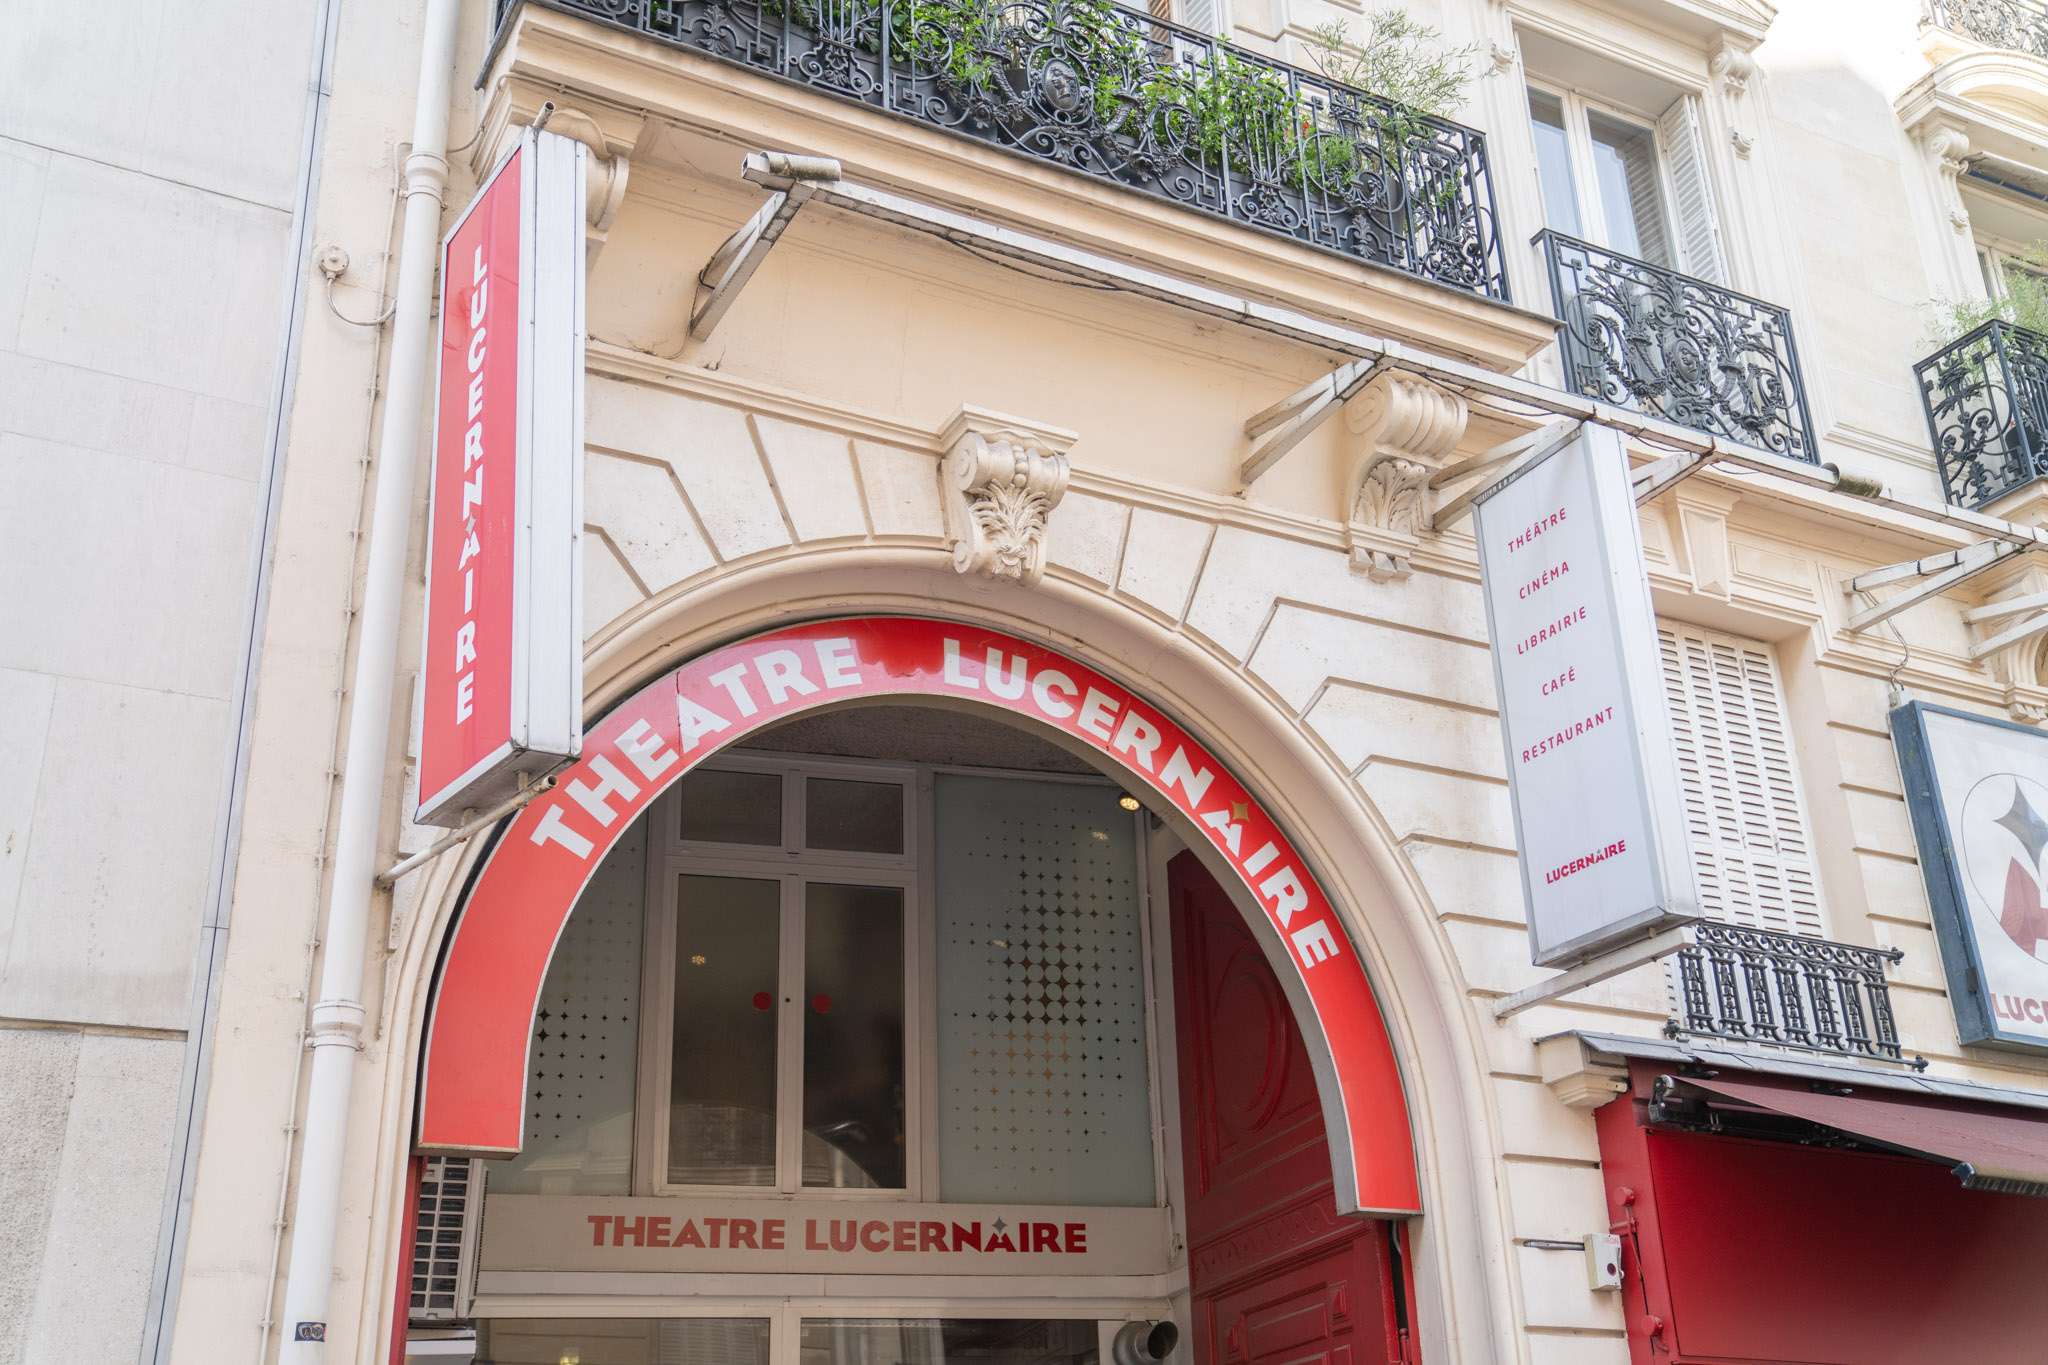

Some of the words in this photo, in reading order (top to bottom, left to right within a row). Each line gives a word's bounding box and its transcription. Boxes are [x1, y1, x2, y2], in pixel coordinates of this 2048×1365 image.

[456, 244, 488, 725] LUCERNAIRE
[1507, 508, 1567, 552] THÉÂTRE
[1519, 560, 1570, 599] CINÉMA
[1517, 606, 1587, 656] LIBRAIRIE
[1542, 667, 1576, 696] CAFÉ
[1522, 706, 1615, 763] RESTAURANT
[530, 637, 862, 861] THEATRE
[943, 637, 1340, 969] LUCERNAIRE
[1546, 839, 1626, 885] LUCERNAIRE
[587, 1214, 785, 1251] THEATRE
[804, 1216, 1088, 1254] LUCERNAIRE
